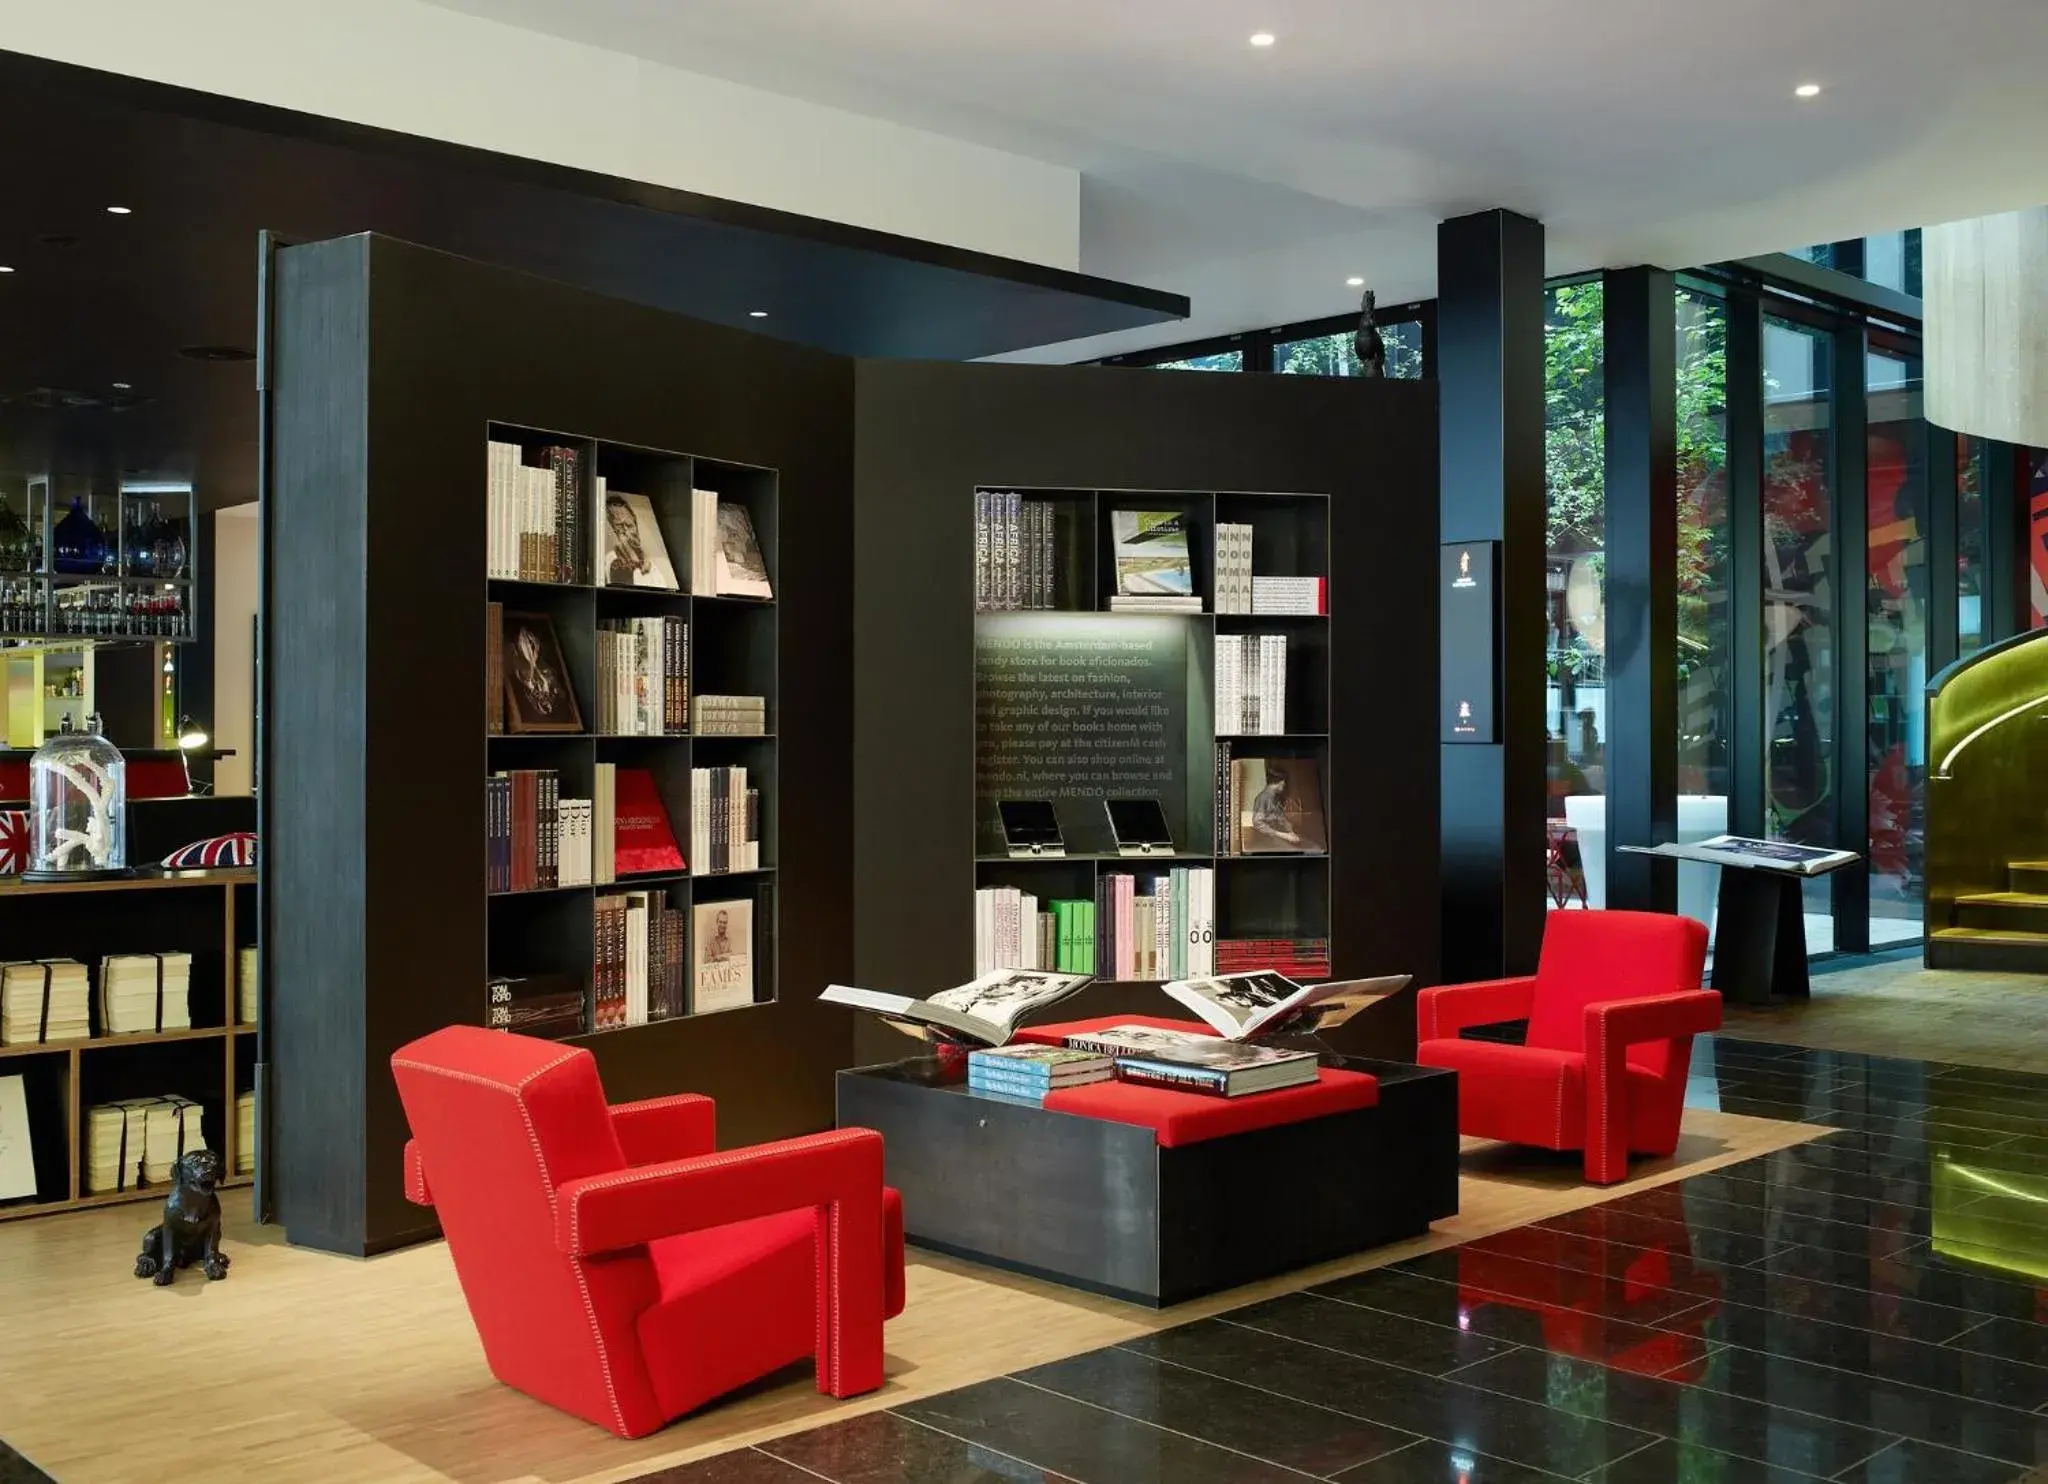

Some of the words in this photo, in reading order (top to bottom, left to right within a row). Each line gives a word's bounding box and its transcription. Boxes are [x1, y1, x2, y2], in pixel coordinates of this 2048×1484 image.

[979, 523, 988, 563] AFRICA
[995, 523, 1004, 564] AFRICA
[1010, 524, 1018, 564] AFRICA
[1218, 533, 1226, 593] NOMA
[1230, 533, 1239, 593] NOMA
[1242, 533, 1251, 593] NOMA
[1034, 639, 1052, 650] the
[1010, 656, 1038, 666] store
[1041, 656, 1058, 666] for
[1059, 656, 1087, 666] book
[1089, 656, 1152, 666] aficionados.
[1018, 672, 1034, 682] the
[1038, 672, 1070, 682] latest
[1088, 672, 1131, 684] fashion,
[977, 688, 1048, 702] hotography,
[1050, 688, 1120, 702] architecture,
[1122, 688, 1162, 699] interior
[1042, 704, 1080, 718] design.
[1094, 704, 1113, 718] you
[1116, 704, 1148, 715] would
[1150, 704, 1170, 715] like
[990, 721, 1014, 732] take
[1016, 721, 1034, 734] any
[1038, 721, 1050, 732] of
[1052, 721, 1070, 732] our
[1073, 721, 1105, 732] books
[1108, 721, 1137, 732] home
[1140, 721, 1163, 732] with
[1001, 738, 1036, 750] please
[1038, 738, 1057, 750] pay
[1061, 738, 1072, 748] at
[1074, 738, 1092, 748] the
[1142, 738, 1166, 748] cash
[977, 754, 1020, 766] gister.
[1024, 754, 1042, 764] You
[1046, 754, 1064, 764] can
[1067, 754, 1088, 764] also
[1091, 754, 1116, 766] shop
[1119, 754, 1152, 764] online
[977, 770, 1030, 783] ndo.nl,
[1032, 770, 1066, 780] where
[1068, 770, 1088, 783] you
[1091, 770, 1110, 780] can
[1112, 770, 1151, 780] browse
[1153, 770, 1173, 780] and
[1004, 786, 1022, 798] the
[1058, 786, 1104, 798] MENDO
[1106, 786, 1162, 798] collection.
[560, 806, 570, 837] Dior
[570, 806, 580, 837] Dior
[582, 806, 590, 836] Dior
[492, 984, 508, 995] TOM
[492, 992, 512, 1003] FORD
[492, 1014, 511, 1024] FORD
